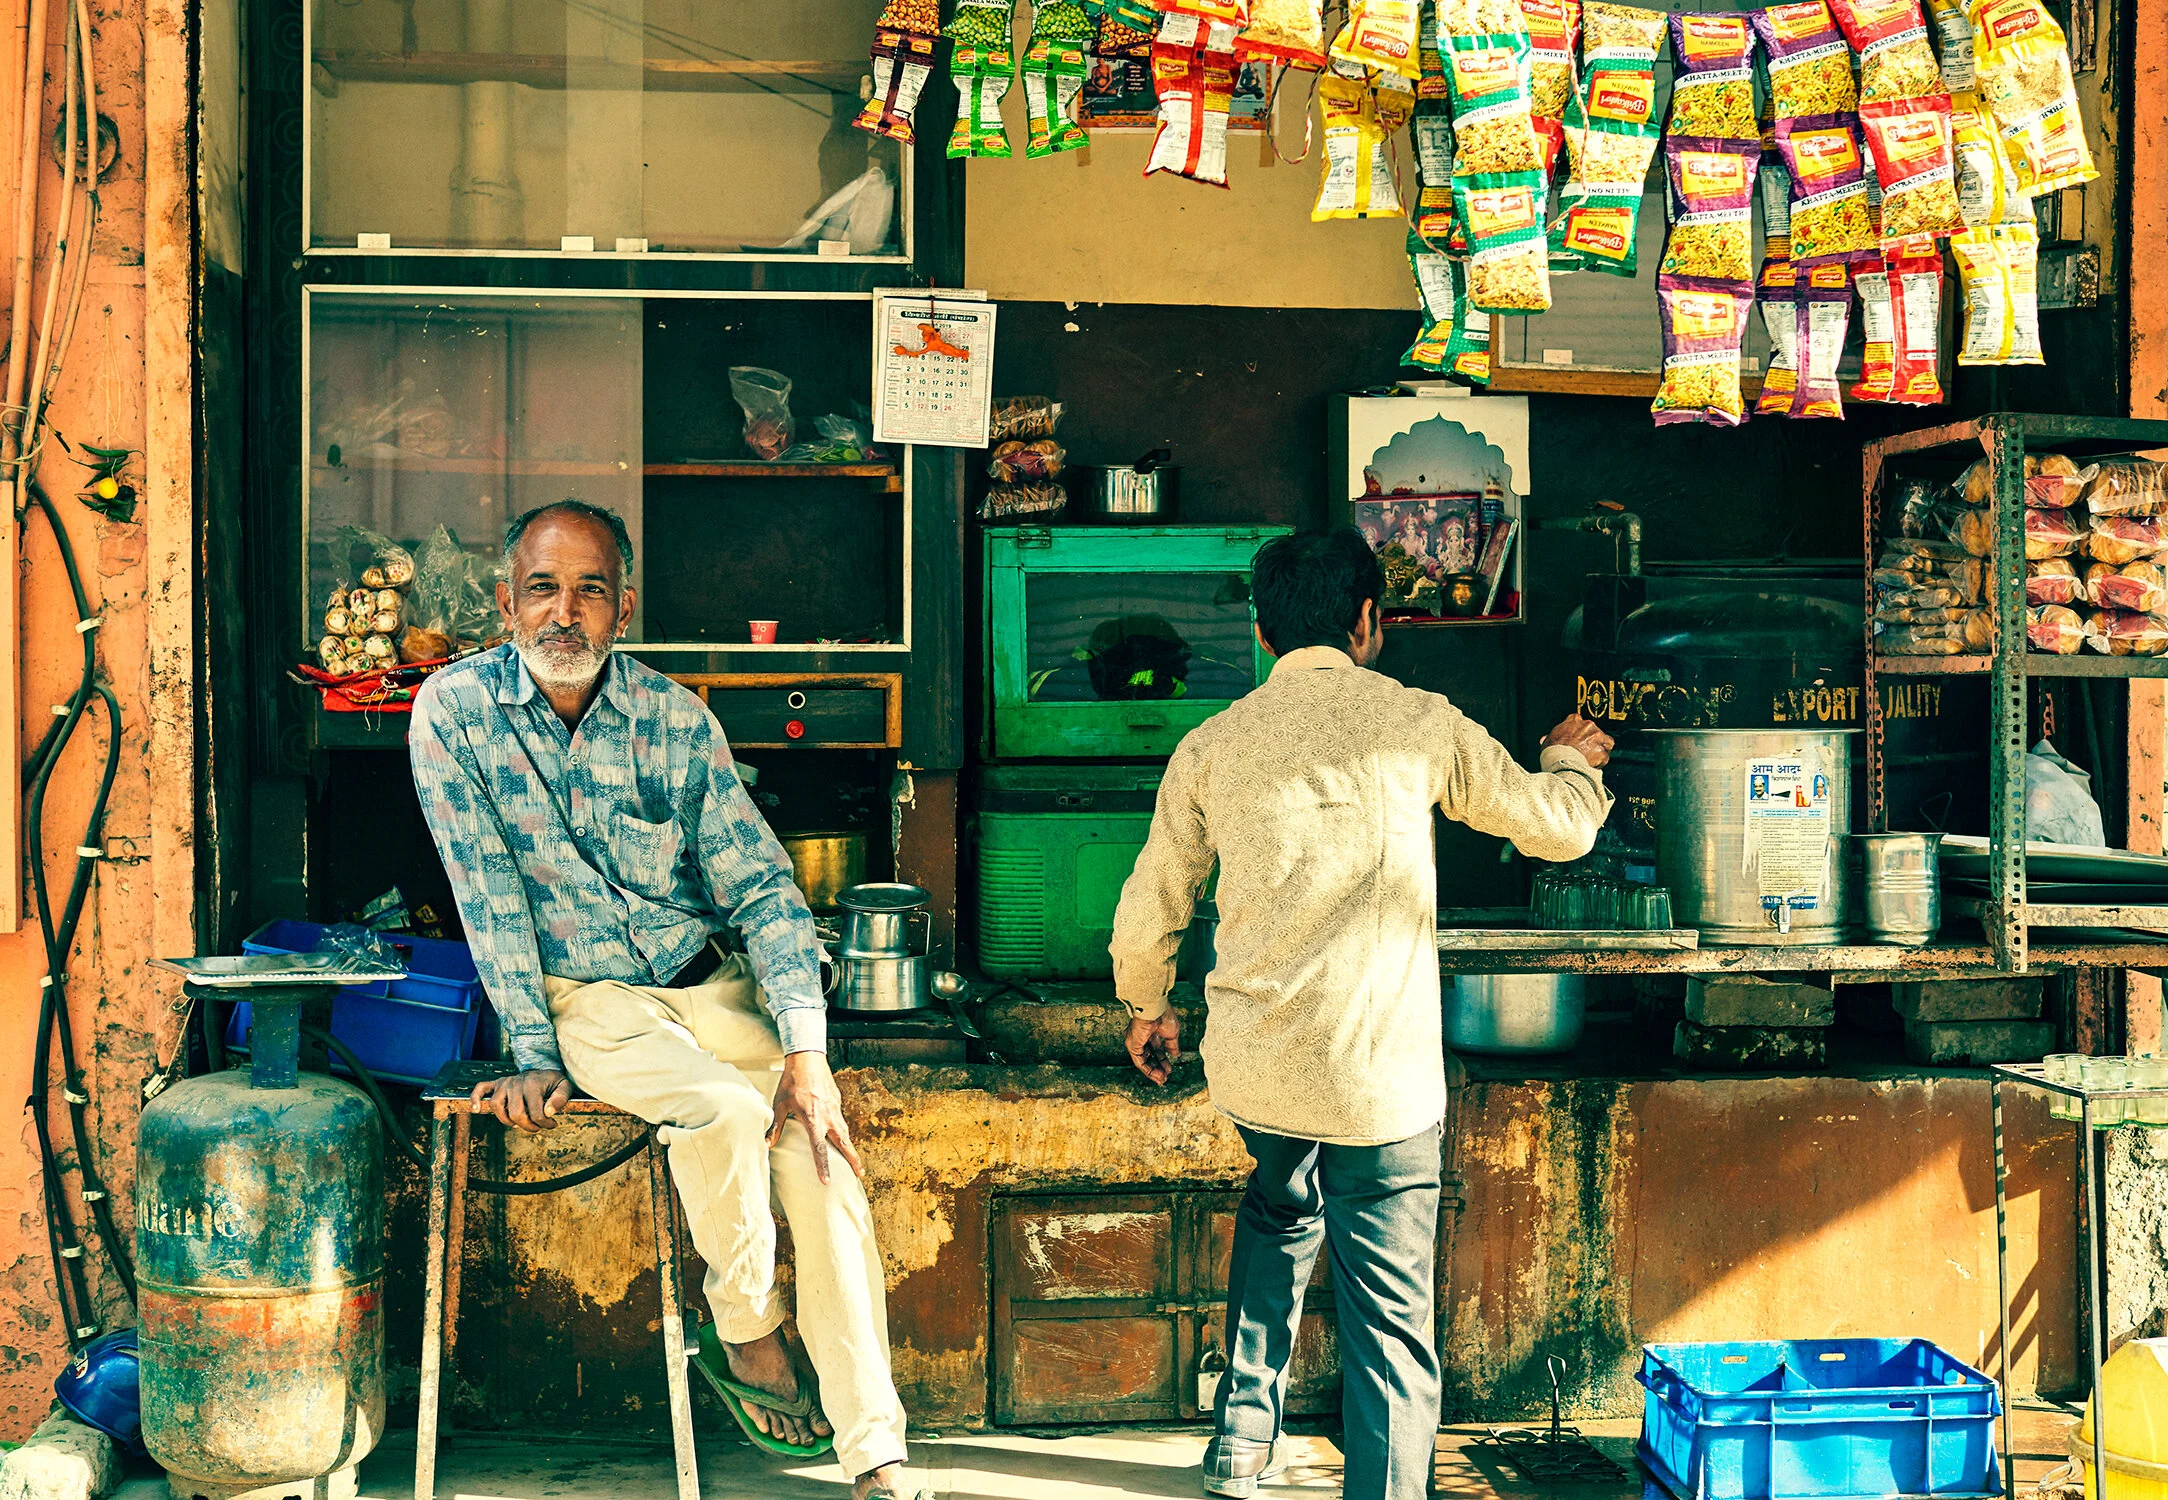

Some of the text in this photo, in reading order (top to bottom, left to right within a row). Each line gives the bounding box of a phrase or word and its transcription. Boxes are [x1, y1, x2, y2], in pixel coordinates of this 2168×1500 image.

[1528, 17, 1558, 28] NAMKEEN
[1778, 42, 1845, 65] KHATTA-MEETHA
[1611, 82, 1641, 93] NAMKEEN
[1680, 210, 1745, 223] KHATTA-MEETH
[1588, 219, 1618, 230] NAMKEEN
[1670, 351, 1735, 364] KHATTA-MEETH
[1773, 686, 1860, 723] EXPORT
[1752, 764, 1774, 774] आम
